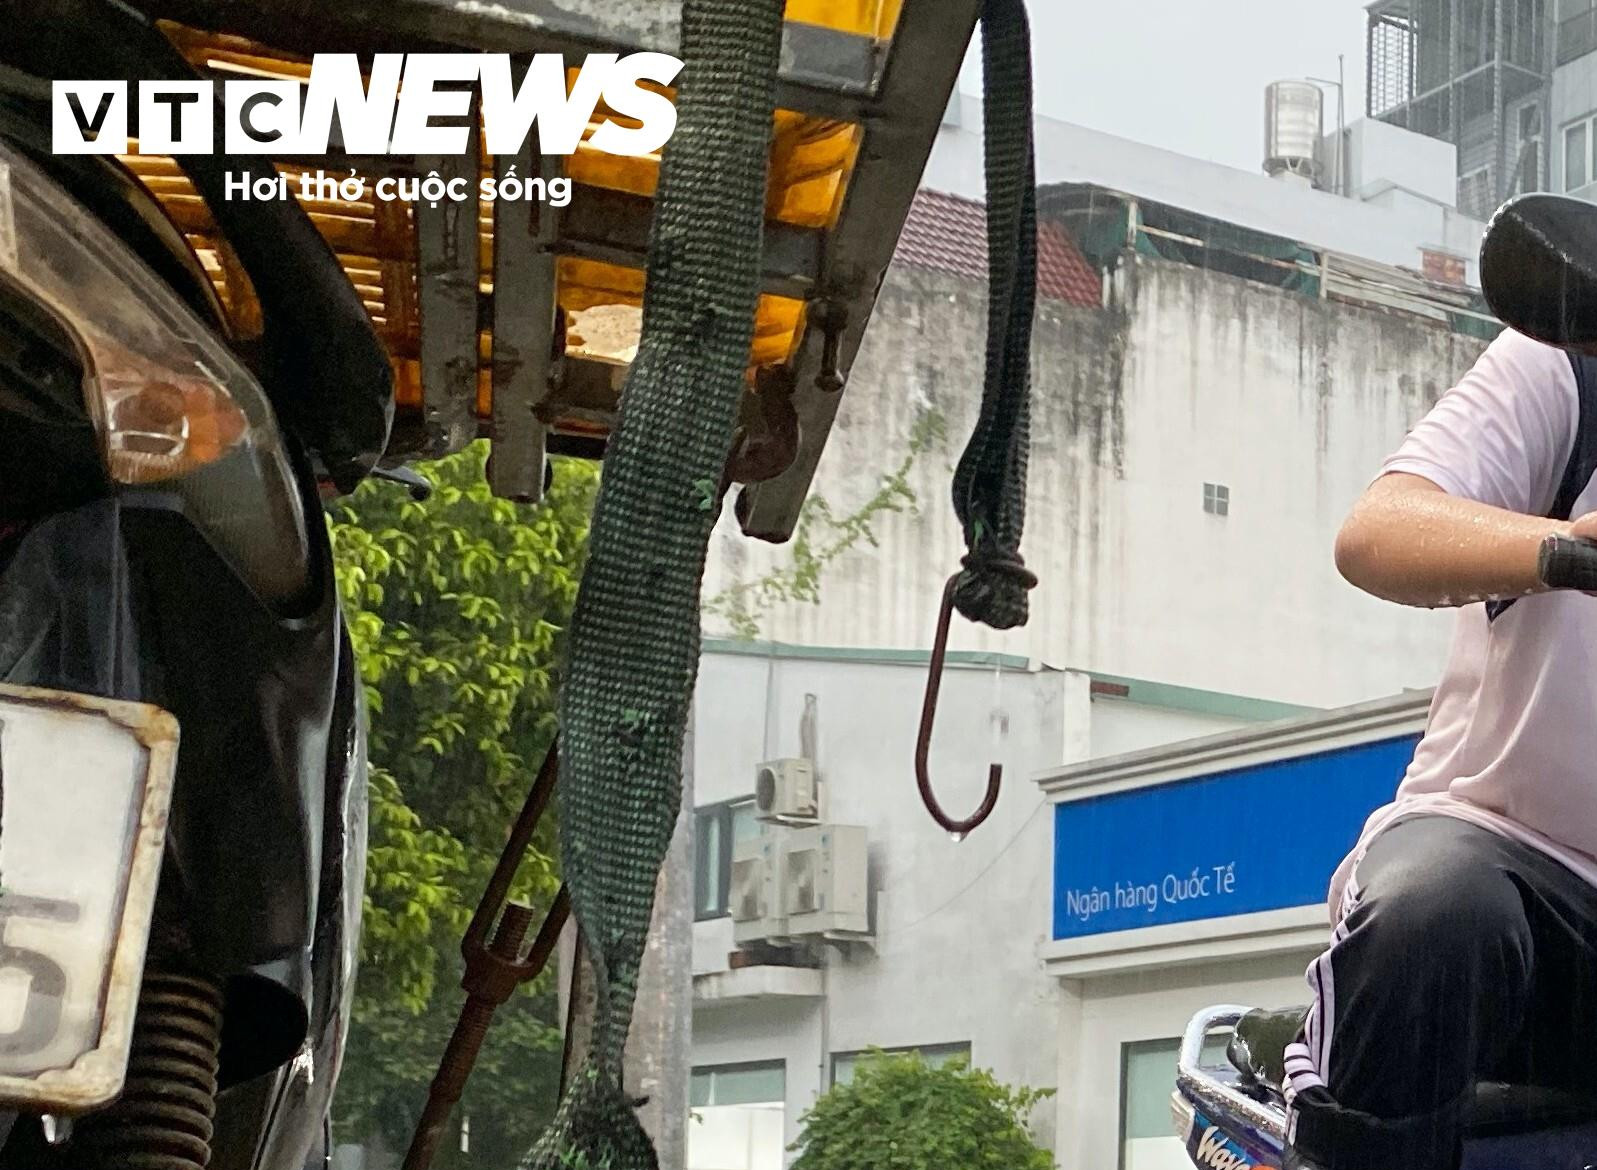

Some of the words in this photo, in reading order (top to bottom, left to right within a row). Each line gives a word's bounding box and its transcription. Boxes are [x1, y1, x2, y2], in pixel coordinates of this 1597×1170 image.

[1066, 886, 1110, 922] Ngân
[1114, 881, 1158, 912] hàng
[1162, 867, 1211, 904] Quốc
[1212, 861, 1236, 895] Tế
